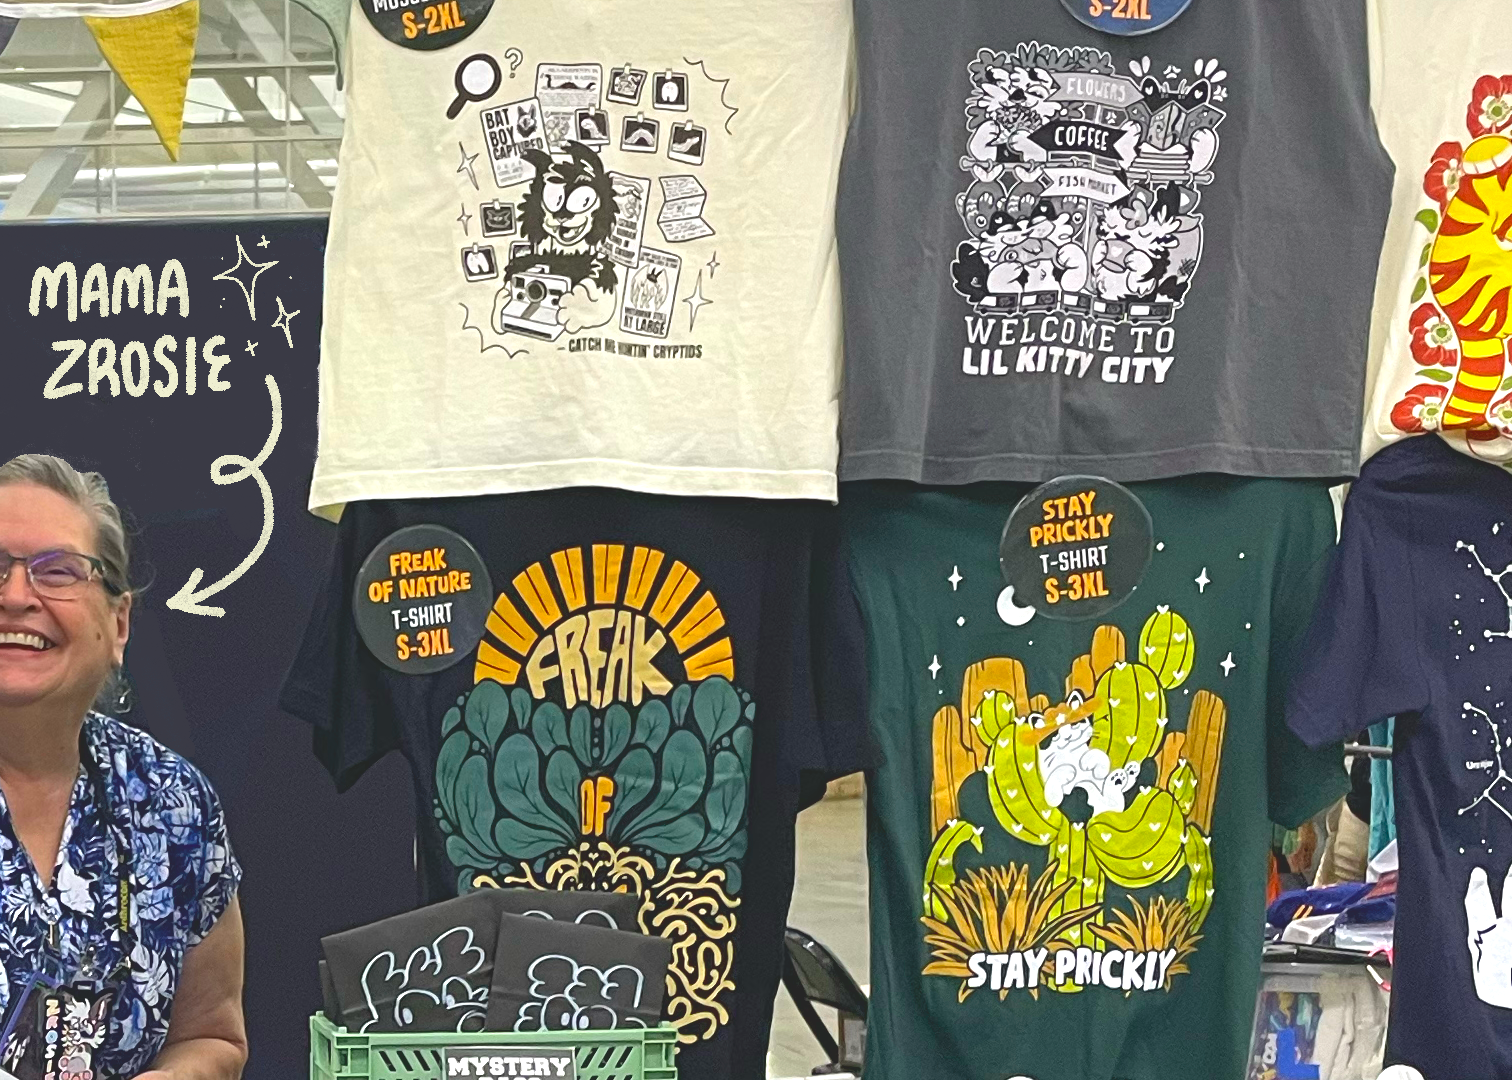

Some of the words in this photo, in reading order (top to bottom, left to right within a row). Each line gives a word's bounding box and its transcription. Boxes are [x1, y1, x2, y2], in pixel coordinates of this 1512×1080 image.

[402, 0, 465, 39] S-2XL
[487, 109, 510, 129] BAT
[489, 125, 516, 148] BOY
[568, 338, 602, 352] CATCH
[965, 316, 1116, 352] WELCOME
[1130, 327, 1176, 352] TO
[962, 347, 1009, 375] LIL
[1015, 345, 1094, 378] KITTY
[1101, 356, 1175, 383] CITY
[390, 548, 447, 574] FREAK
[369, 577, 393, 603] OF
[399, 570, 472, 599] NATURE
[391, 603, 453, 631] T-SHIRT
[396, 628, 454, 660] S-3XL
[526, 607, 674, 709] FREAK
[580, 776, 614, 836] OF
[967, 951, 1048, 992] STAY
[1055, 947, 1177, 992] PRICKLY
[448, 1057, 571, 1077] MYSTERY
